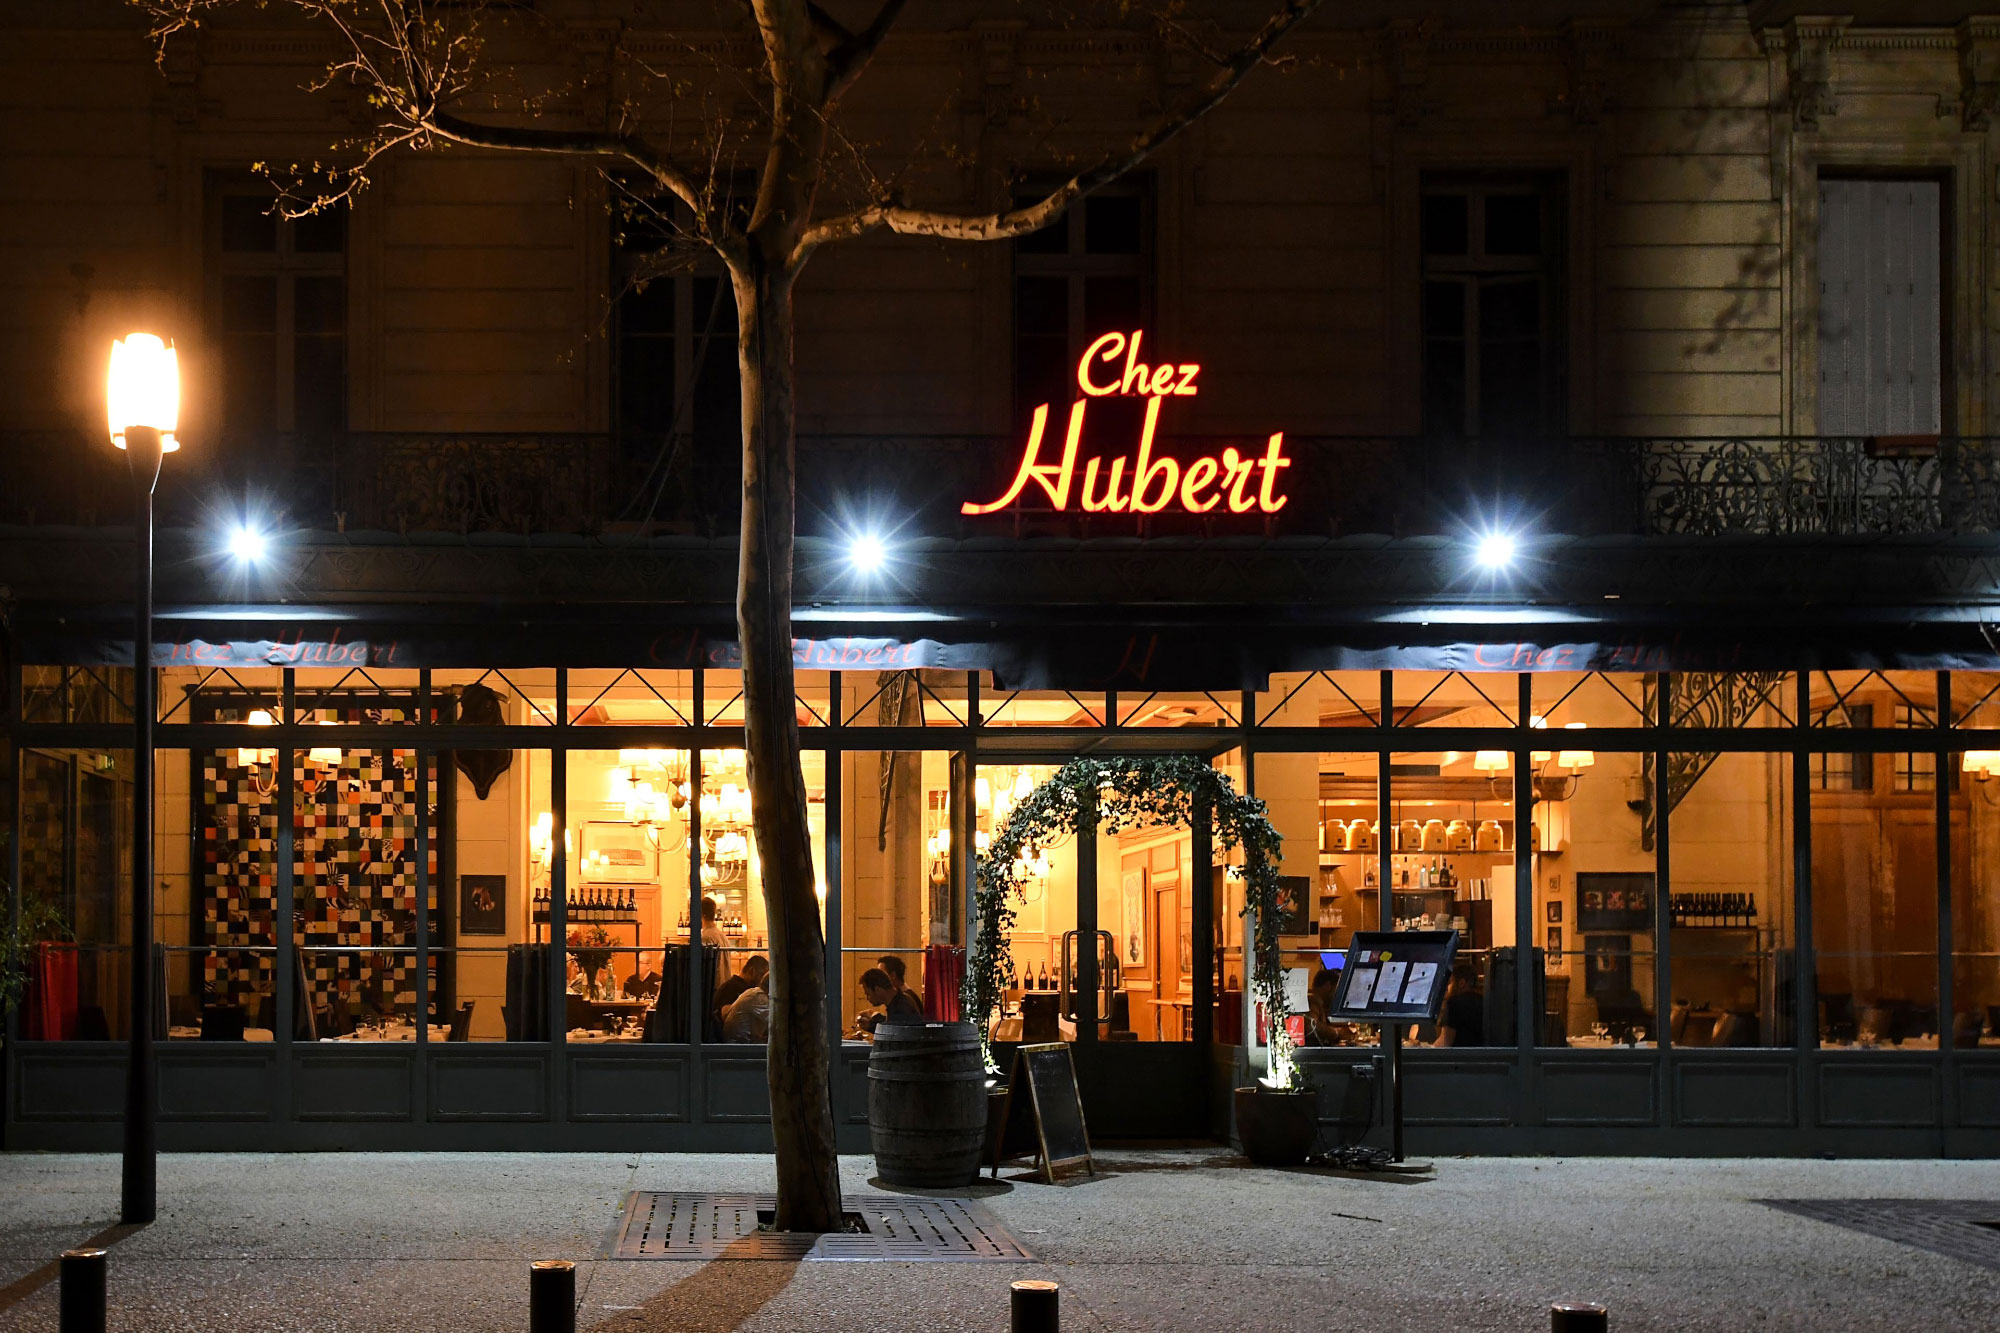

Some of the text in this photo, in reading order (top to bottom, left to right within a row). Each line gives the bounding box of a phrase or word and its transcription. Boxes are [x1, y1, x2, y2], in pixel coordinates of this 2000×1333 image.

[1078, 329, 1200, 396] Chez
[961, 394, 1291, 515] Hubert
[245, 626, 398, 662] Hubert
[1474, 637, 1575, 666] Chez
